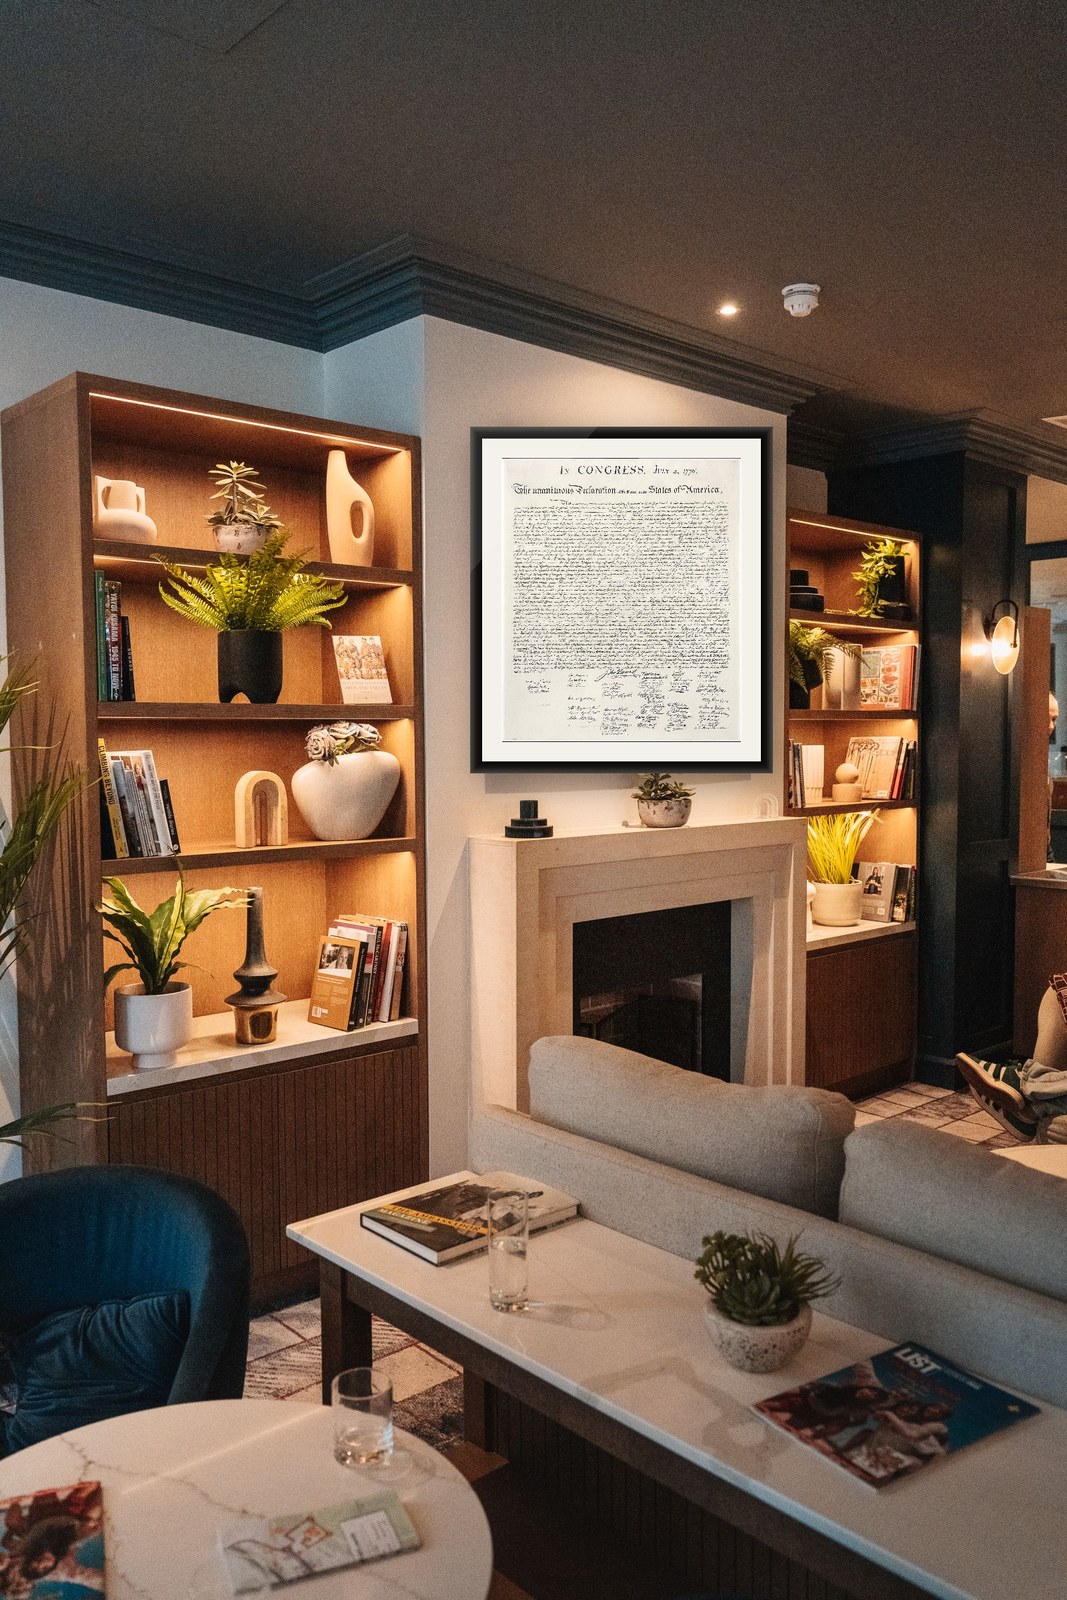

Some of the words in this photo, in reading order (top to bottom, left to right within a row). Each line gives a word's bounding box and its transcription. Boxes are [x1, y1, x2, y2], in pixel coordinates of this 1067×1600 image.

[648, 485, 672, 495] States
[110, 593, 118, 612] YAYOI
[110, 613, 119, 642] KUSAMA
[111, 646, 119, 663] 1945
[112, 663, 119, 672] TO
[111, 672, 121, 691] NOW
[98, 745, 109, 779] CLIMBING
[104, 778, 115, 805] BEYOND
[378, 1208, 430, 1225] MAGAZINE
[415, 1212, 481, 1232] AMBASSADOR
[893, 1347, 943, 1374] LIST
